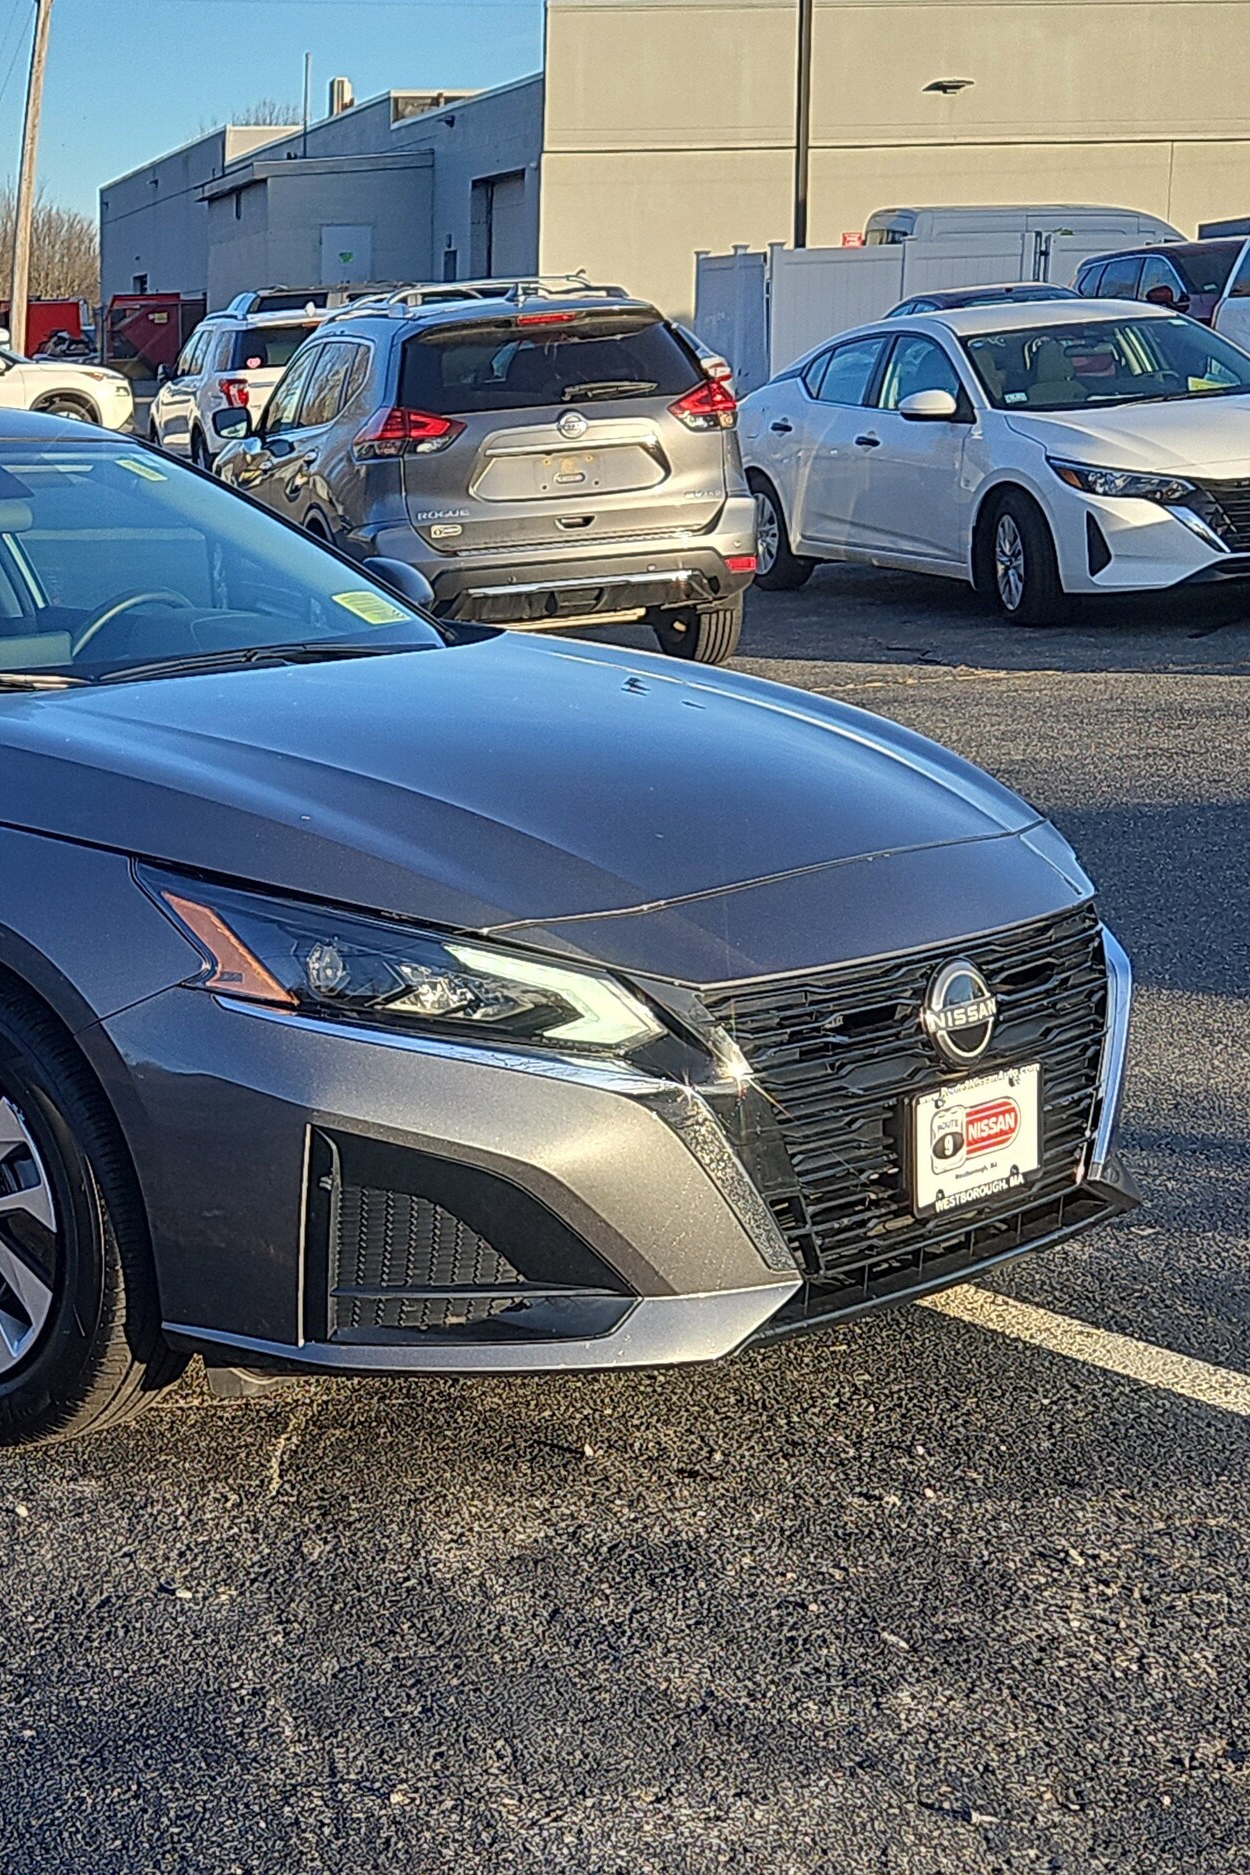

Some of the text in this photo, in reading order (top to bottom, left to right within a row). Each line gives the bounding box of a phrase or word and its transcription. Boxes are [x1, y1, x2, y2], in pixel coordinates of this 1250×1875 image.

[417, 509, 470, 521] ROGUE
[925, 996, 997, 1032] NISSAN
[937, 1119, 959, 1132] ROUTE
[967, 1111, 1016, 1142] NISSAN
[943, 1134, 954, 1156] 9
[1009, 1172, 1025, 1188] MA
